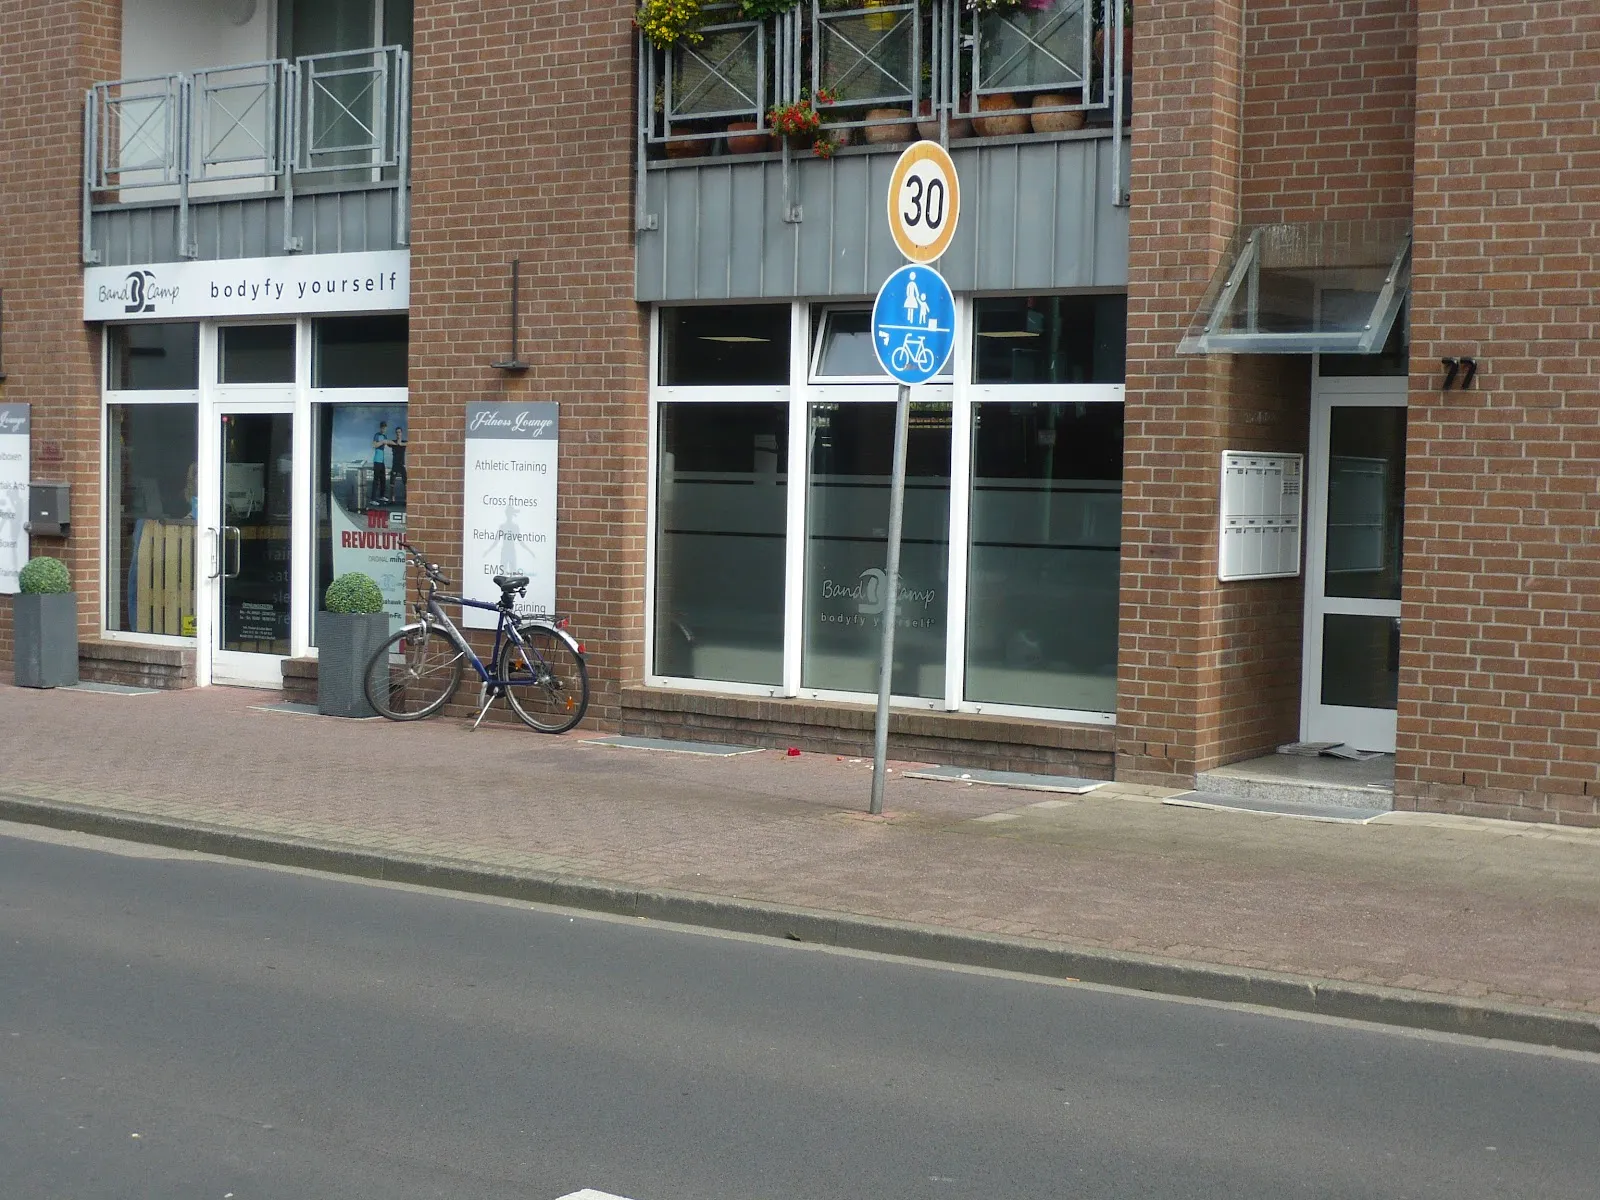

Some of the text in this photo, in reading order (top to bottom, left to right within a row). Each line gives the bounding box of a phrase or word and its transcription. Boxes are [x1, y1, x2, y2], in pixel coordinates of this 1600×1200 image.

[903, 174, 945, 230] 30
[98, 283, 129, 303] Band
[147, 283, 180, 304] Camp
[210, 278, 285, 301] bodyfy
[298, 272, 398, 299] yourself
[1441, 357, 1478, 390] 77
[469, 411, 553, 438] Fitness Lounge
[474, 459, 548, 475] Athletic Training
[482, 494, 538, 507] Cross fitness
[367, 510, 389, 529] DIE
[473, 529, 547, 543] Reha/Prävention
[483, 564, 505, 576] EMS
[821, 579, 936, 609] Band amp
[513, 601, 547, 615] raining
[820, 613, 932, 628] bodyfy yrself
